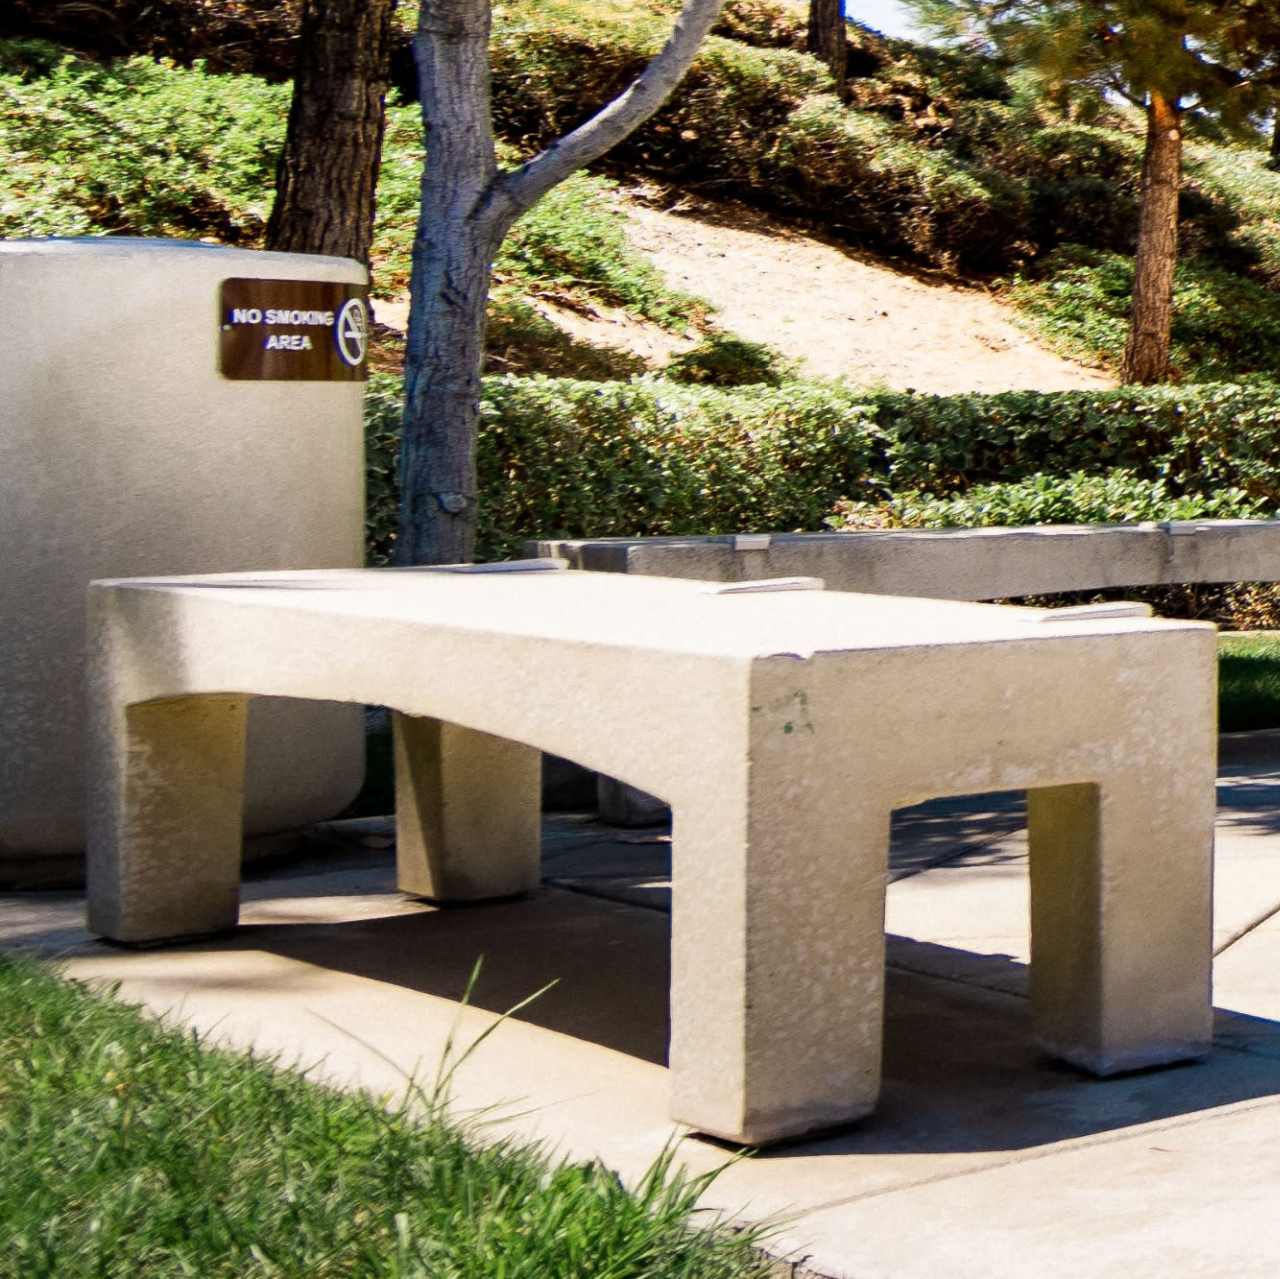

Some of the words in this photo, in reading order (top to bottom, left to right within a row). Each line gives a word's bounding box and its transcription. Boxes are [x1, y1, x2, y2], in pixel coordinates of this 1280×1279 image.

[233, 308, 262, 323] NO
[265, 309, 334, 325] SMOKING
[266, 335, 313, 349] AREA
